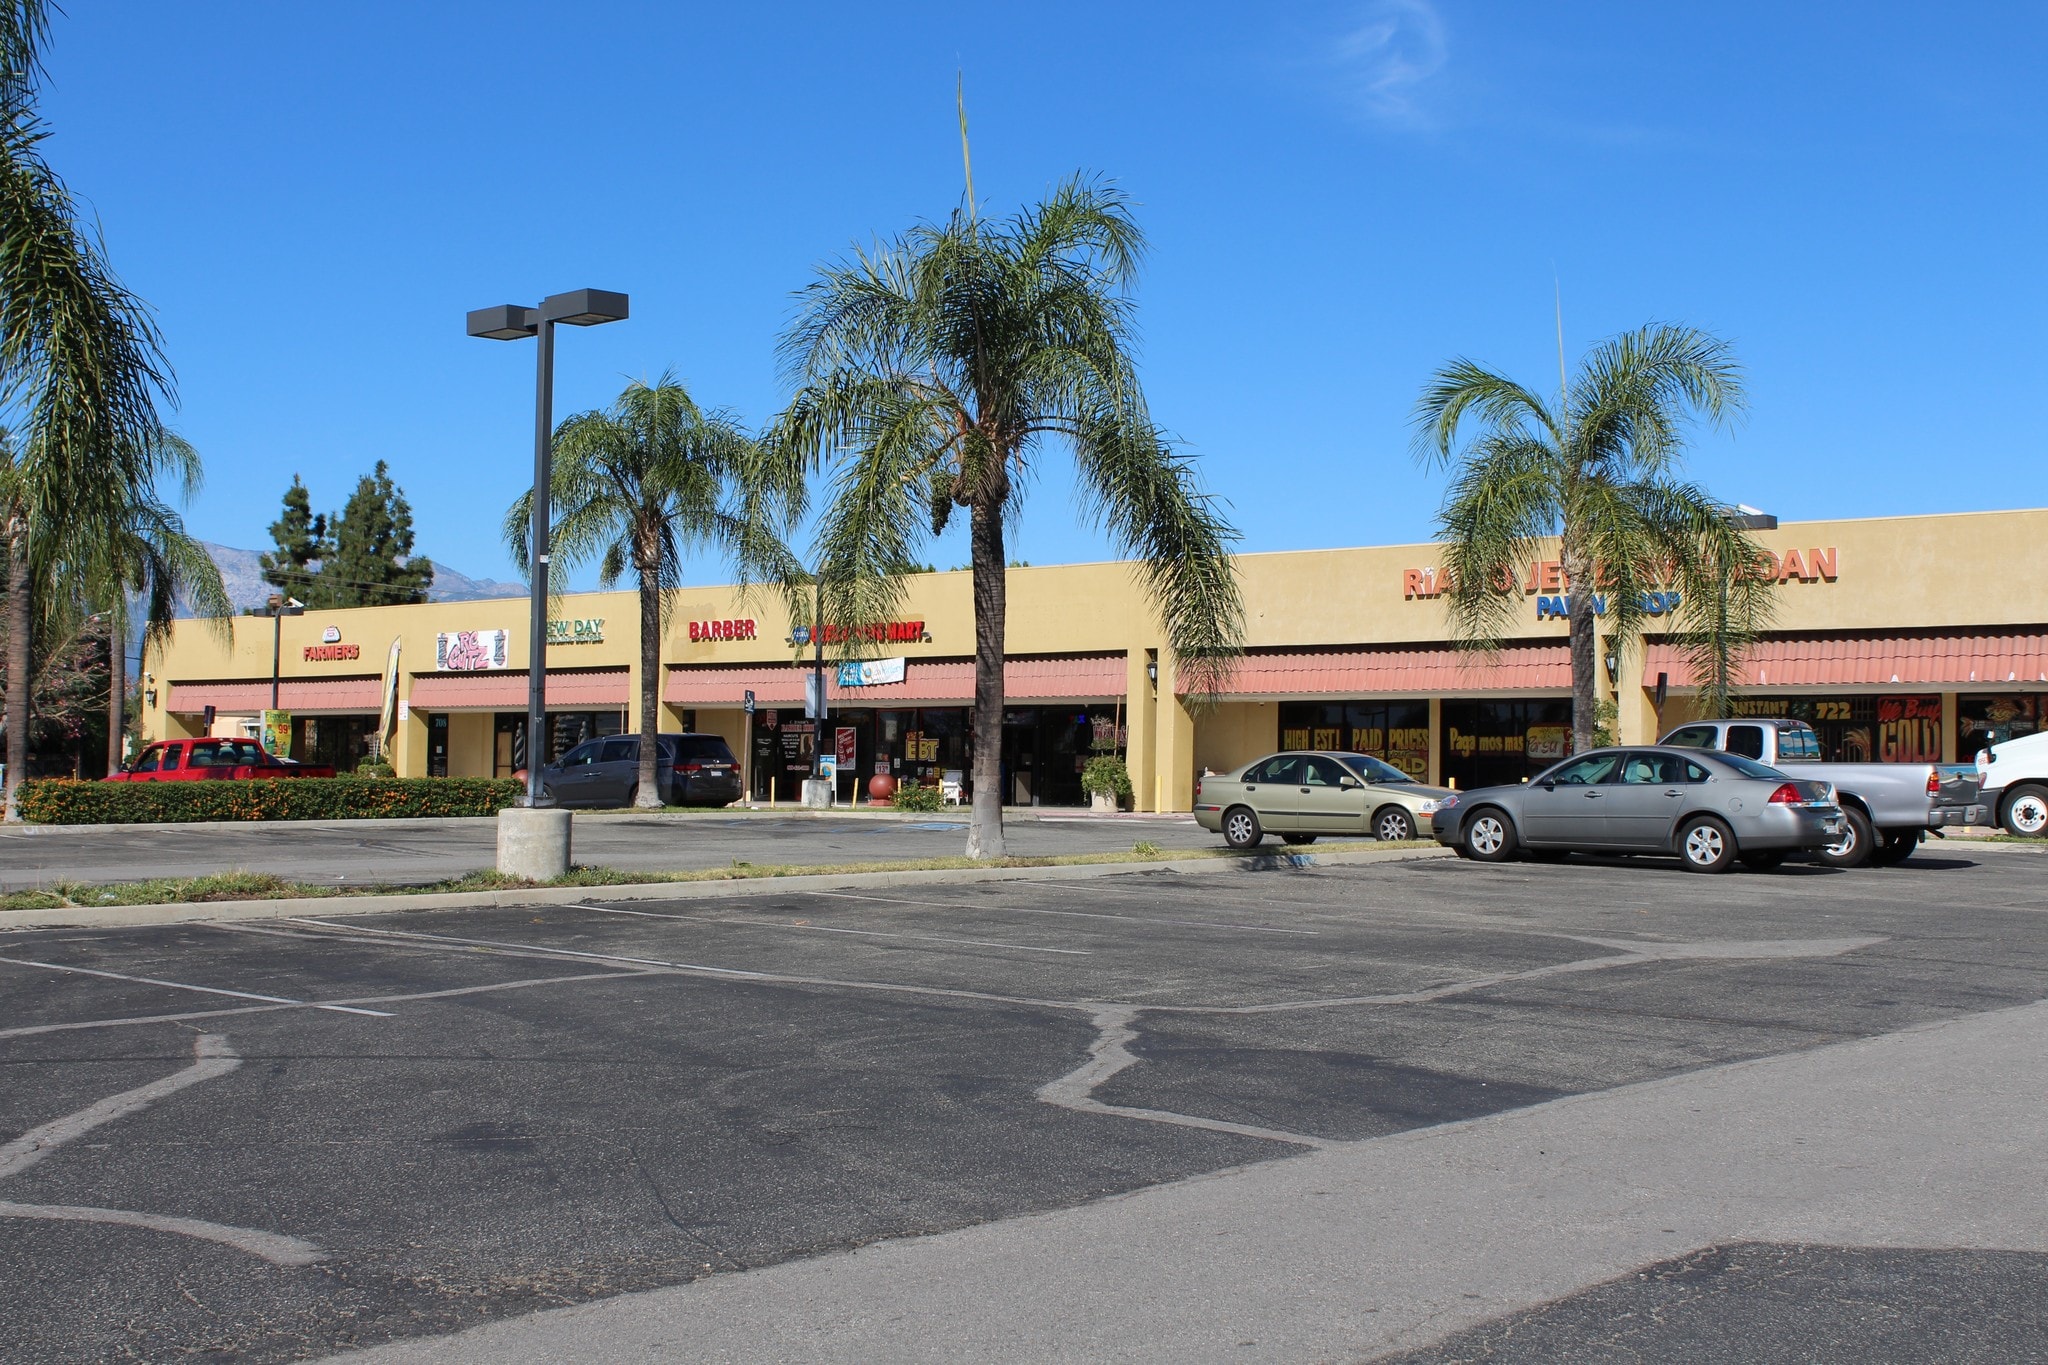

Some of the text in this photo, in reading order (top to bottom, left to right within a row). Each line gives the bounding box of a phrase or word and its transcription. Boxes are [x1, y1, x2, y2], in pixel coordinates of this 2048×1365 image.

[574, 619, 604, 634] DAY
[689, 619, 757, 641] BARBER
[886, 621, 925, 641] MART
[458, 631, 480, 651] RC
[303, 645, 359, 661] FARMERS
[447, 645, 491, 670] CUTZ
[1816, 702, 1851, 720] 722
[1284, 728, 1429, 750] HIGH EST! PAID PRICES
[1449, 727, 1476, 758] Paga
[1479, 736, 1503, 751] mos
[1879, 719, 1941, 763] GOLD
[905, 738, 939, 762] EBT
[1378, 757, 1426, 773] OLD
